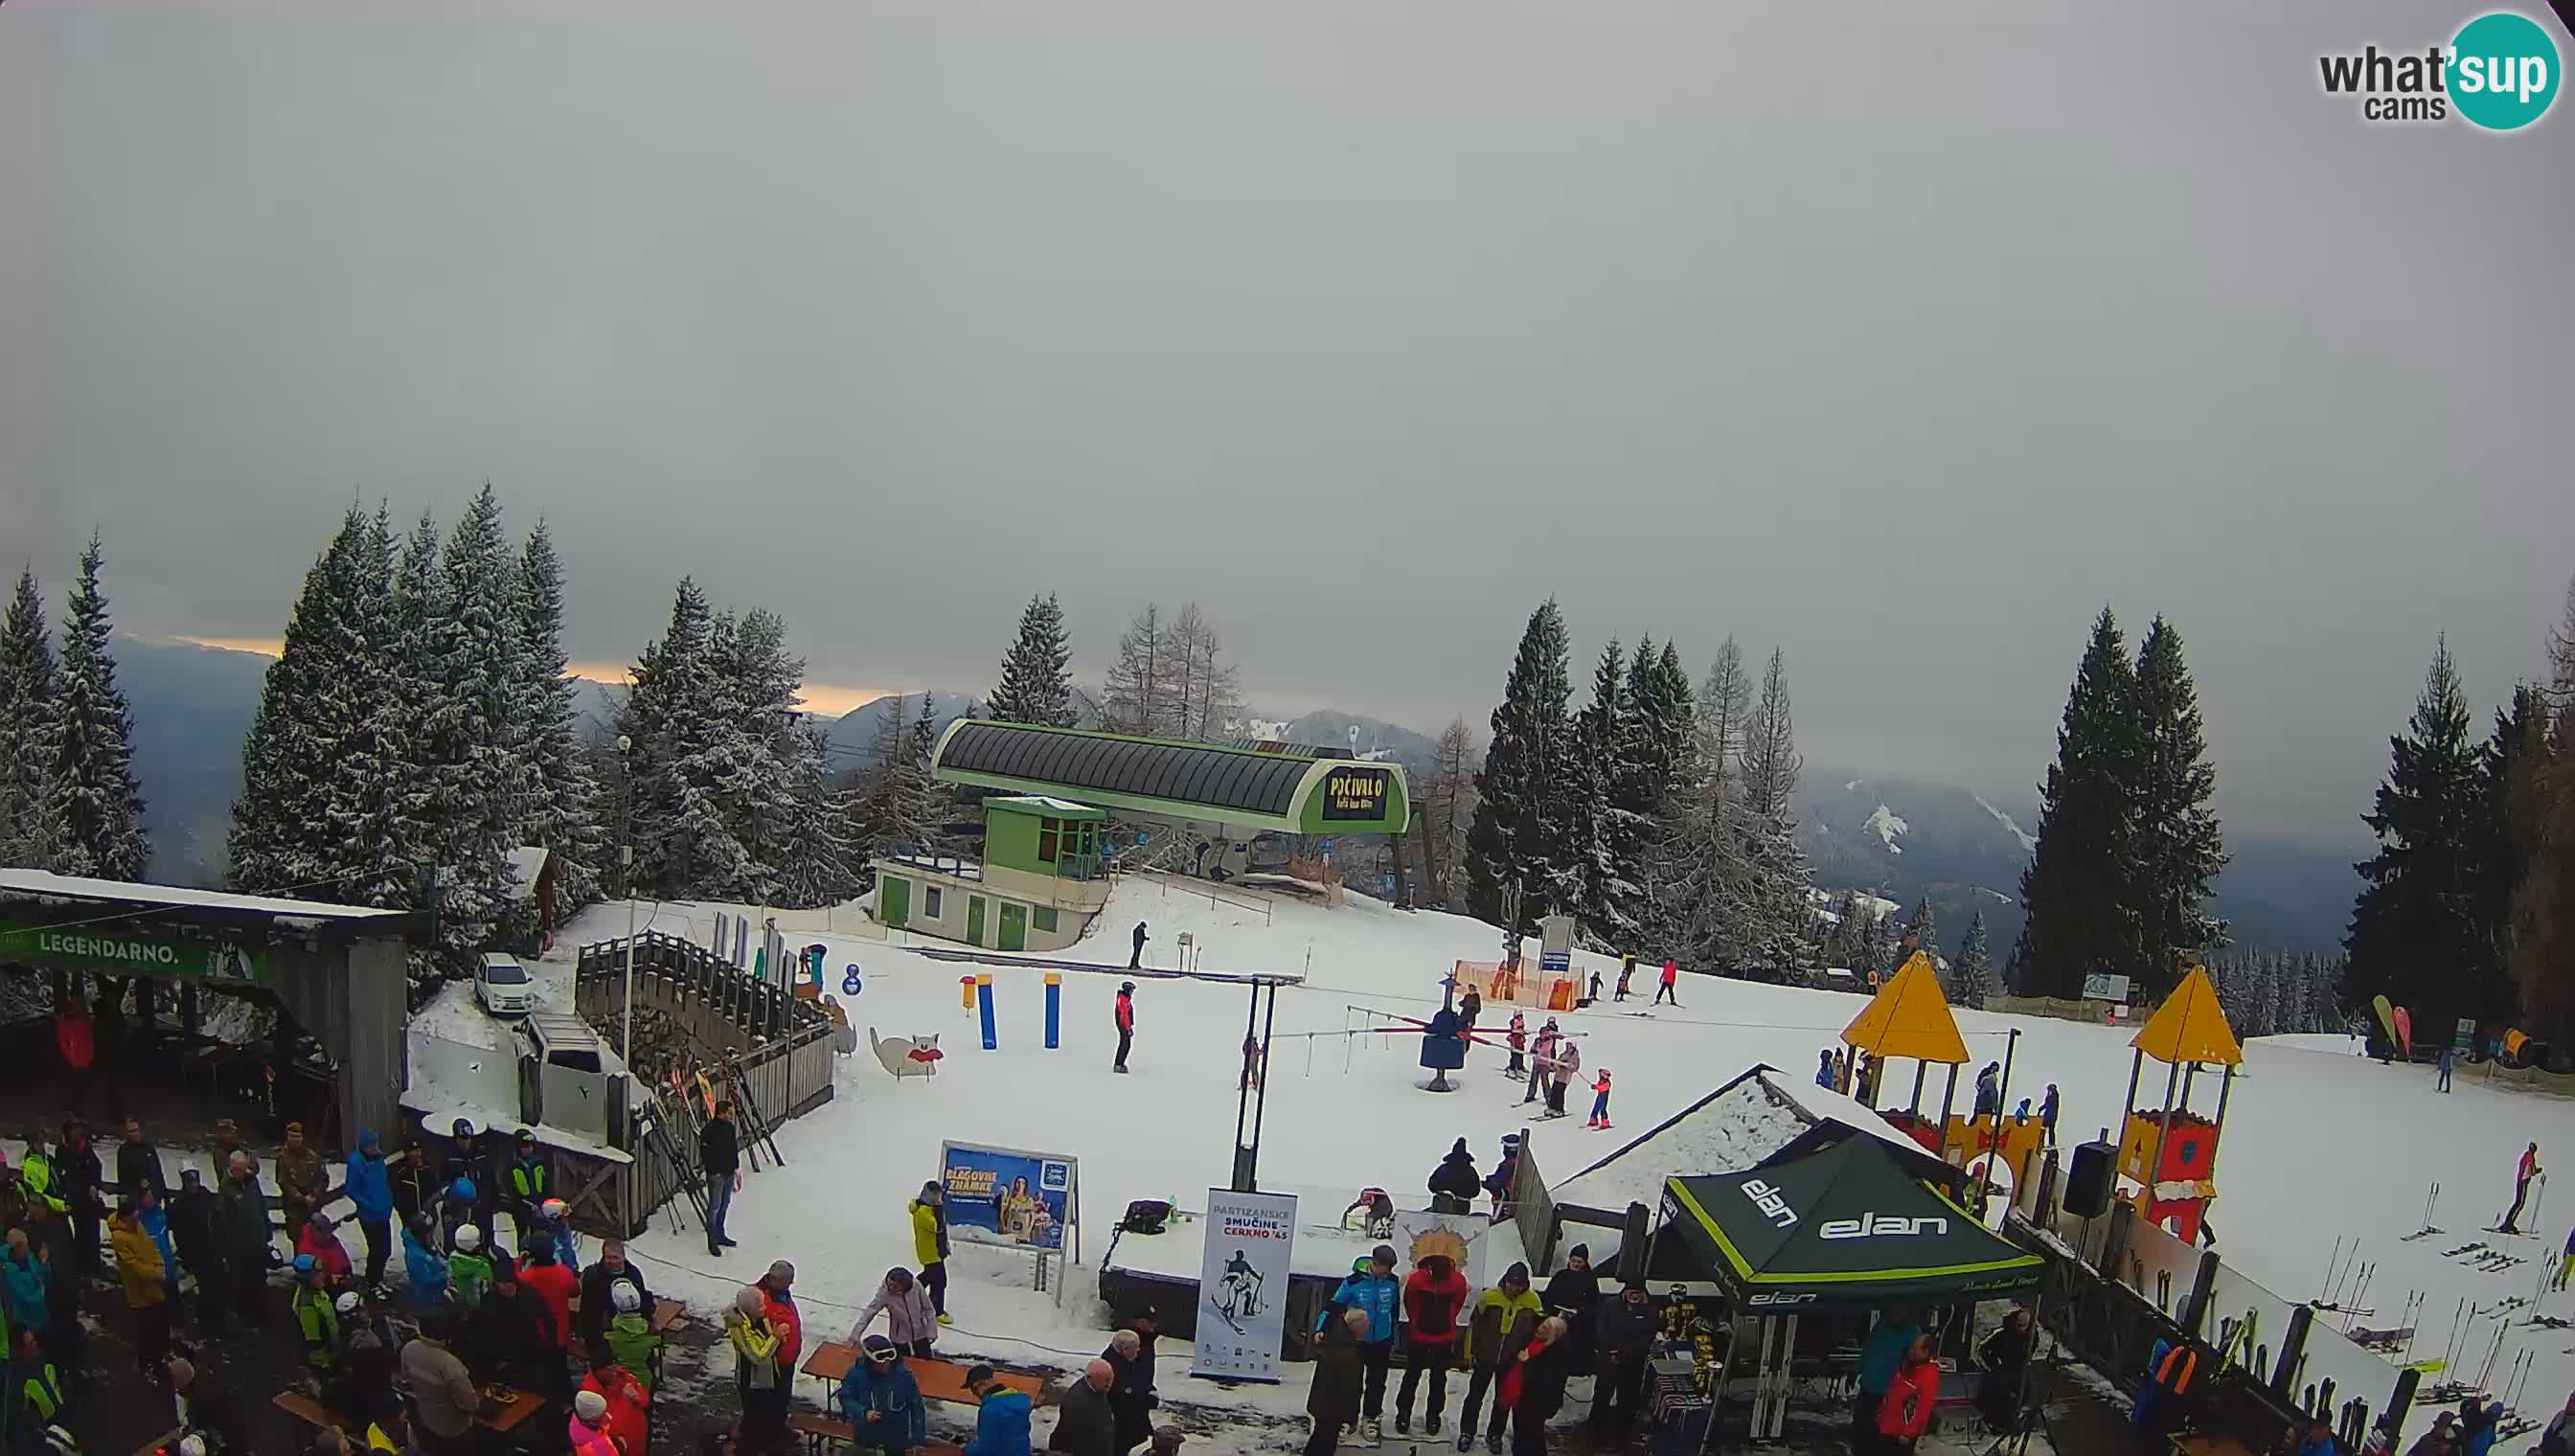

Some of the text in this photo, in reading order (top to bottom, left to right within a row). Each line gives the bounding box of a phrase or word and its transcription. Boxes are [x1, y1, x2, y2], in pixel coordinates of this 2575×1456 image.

[39, 932, 180, 965] LEGENDARNO.
[1740, 1179, 1801, 1228] elan
[1213, 1205, 1288, 1219] PARTIZANSKE
[1225, 1217, 1278, 1229] SMUČINE
[1819, 1212, 1948, 1239] elan
[1223, 1227, 1269, 1239] CERKNO
[1748, 1291, 1817, 1306] elan
